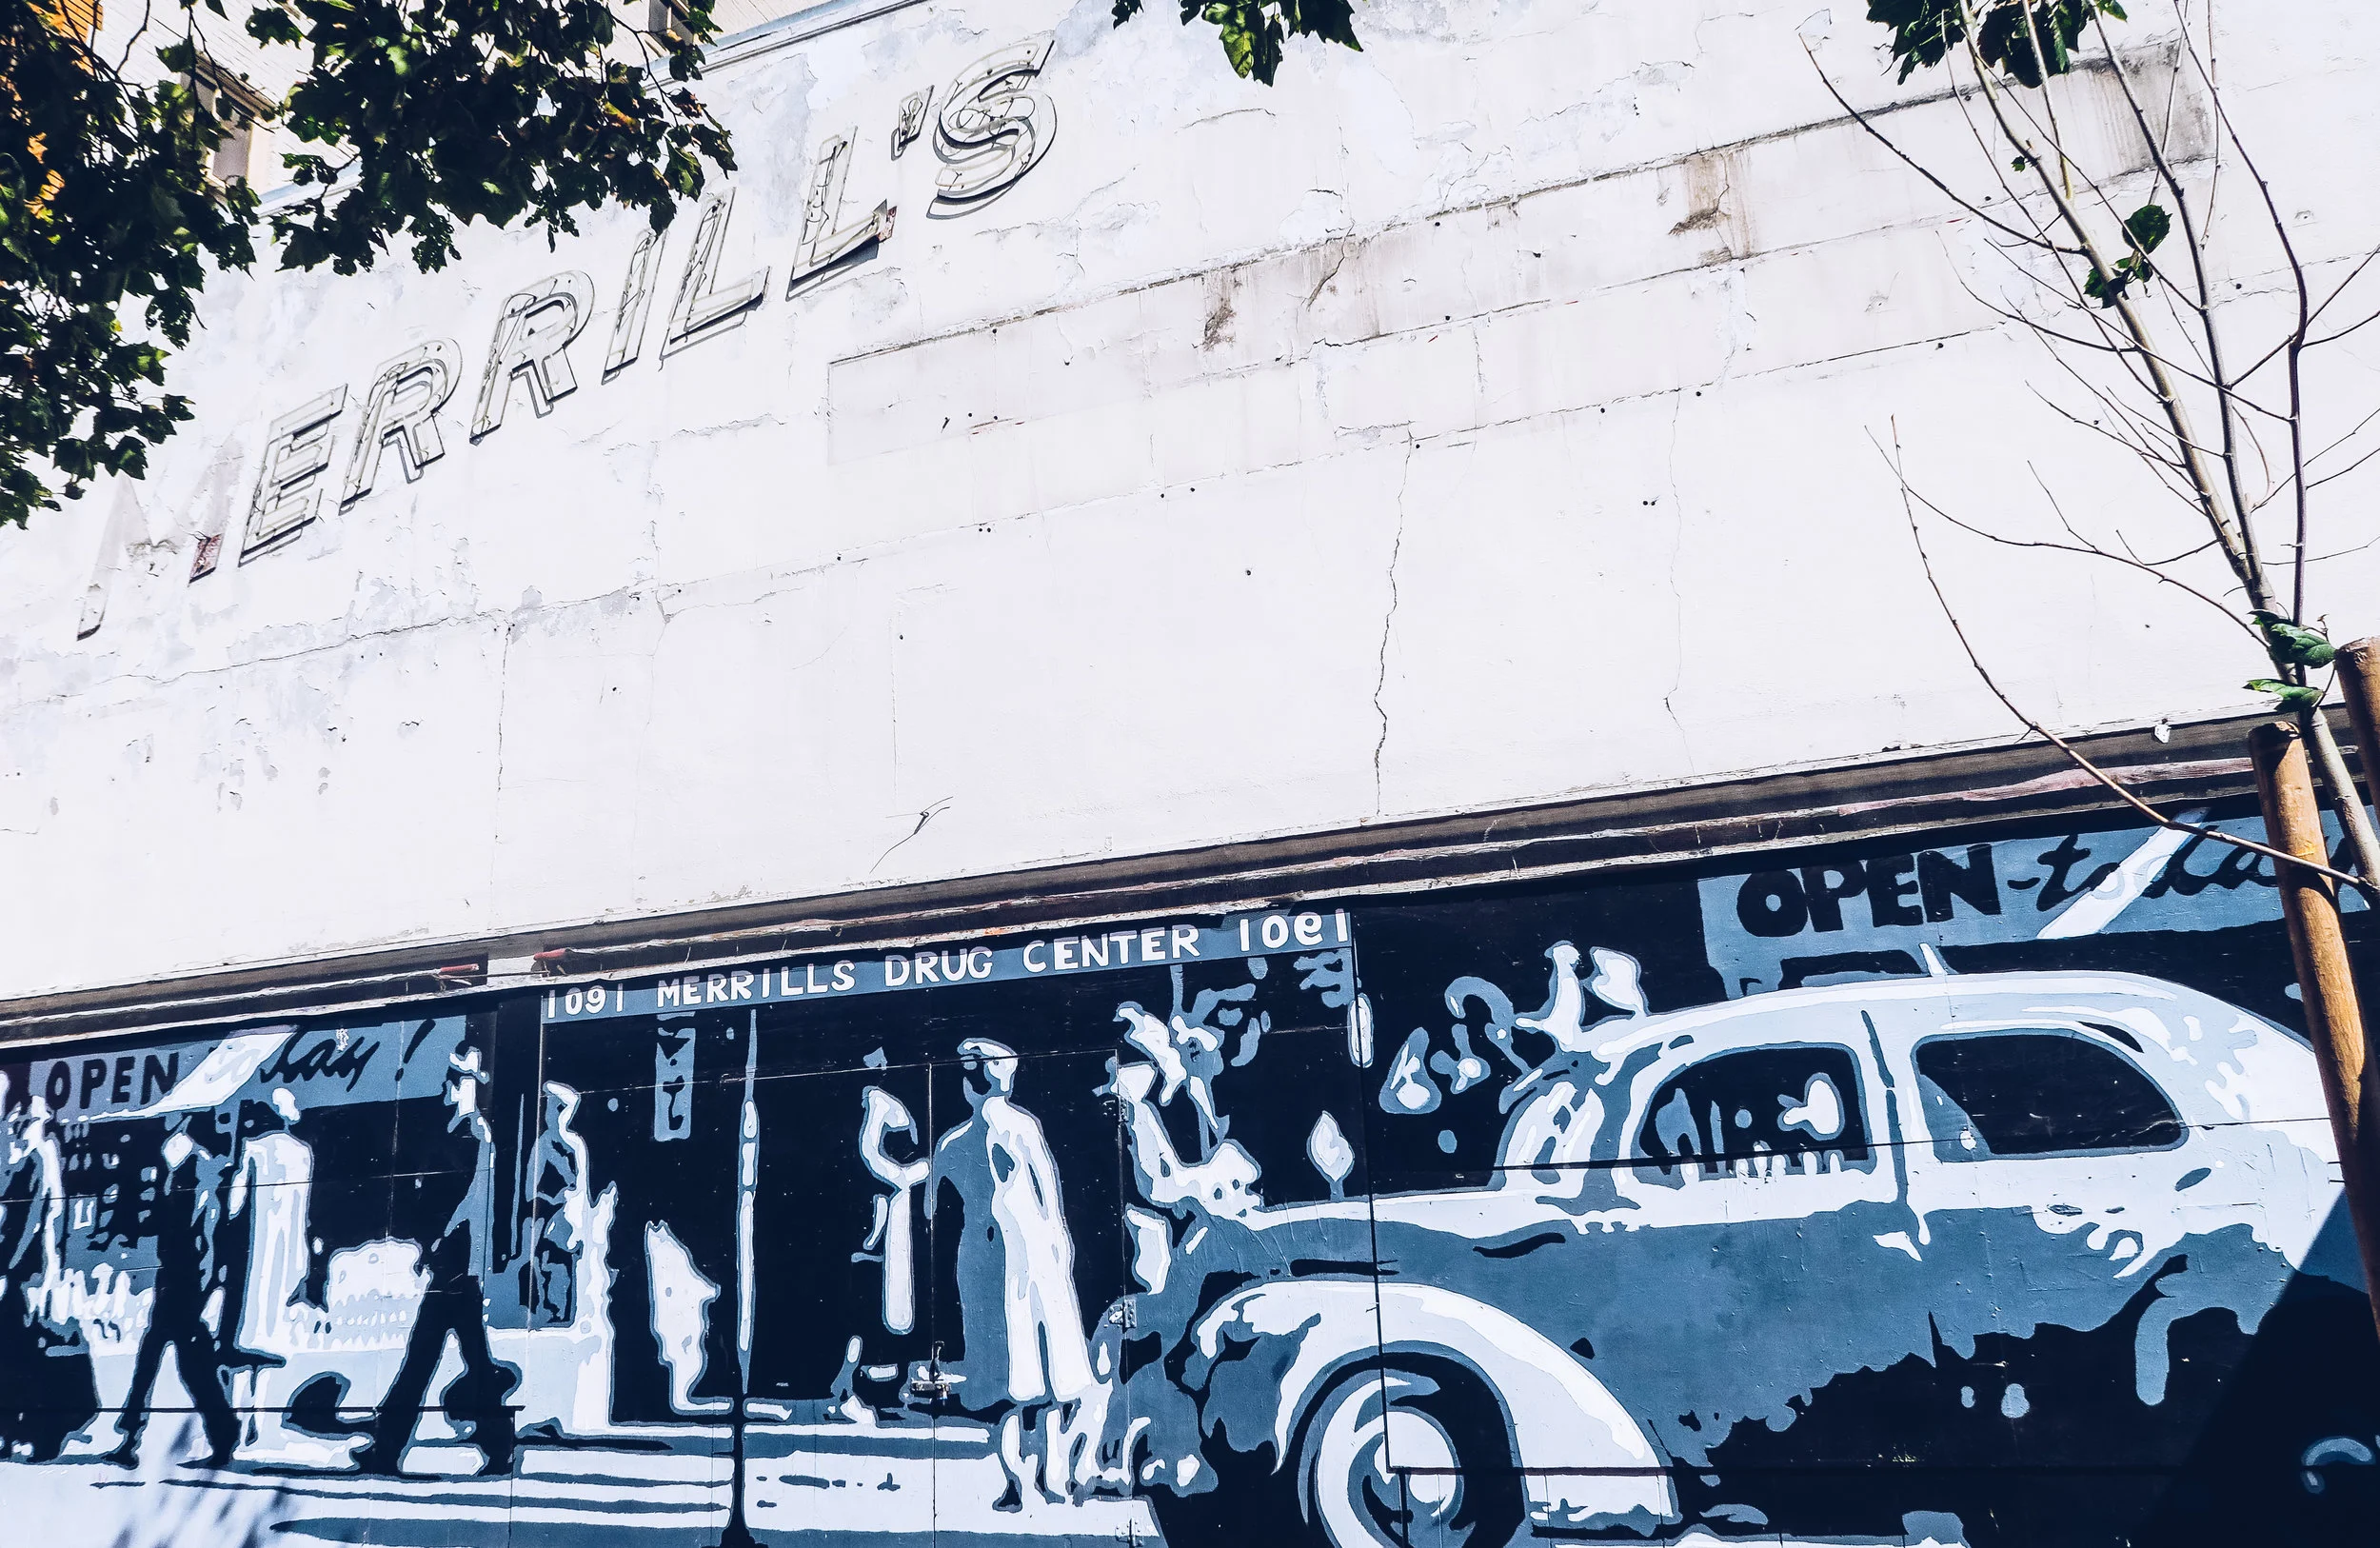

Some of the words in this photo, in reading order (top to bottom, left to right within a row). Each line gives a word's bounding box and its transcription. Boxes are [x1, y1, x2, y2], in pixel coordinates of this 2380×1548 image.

[546, 982, 625, 1019] 1091
[657, 959, 856, 1009] MERRILLS
[884, 944, 993, 987] DRUG
[1022, 923, 1201, 973] CENTER
[46, 1051, 180, 1111] OPEN
